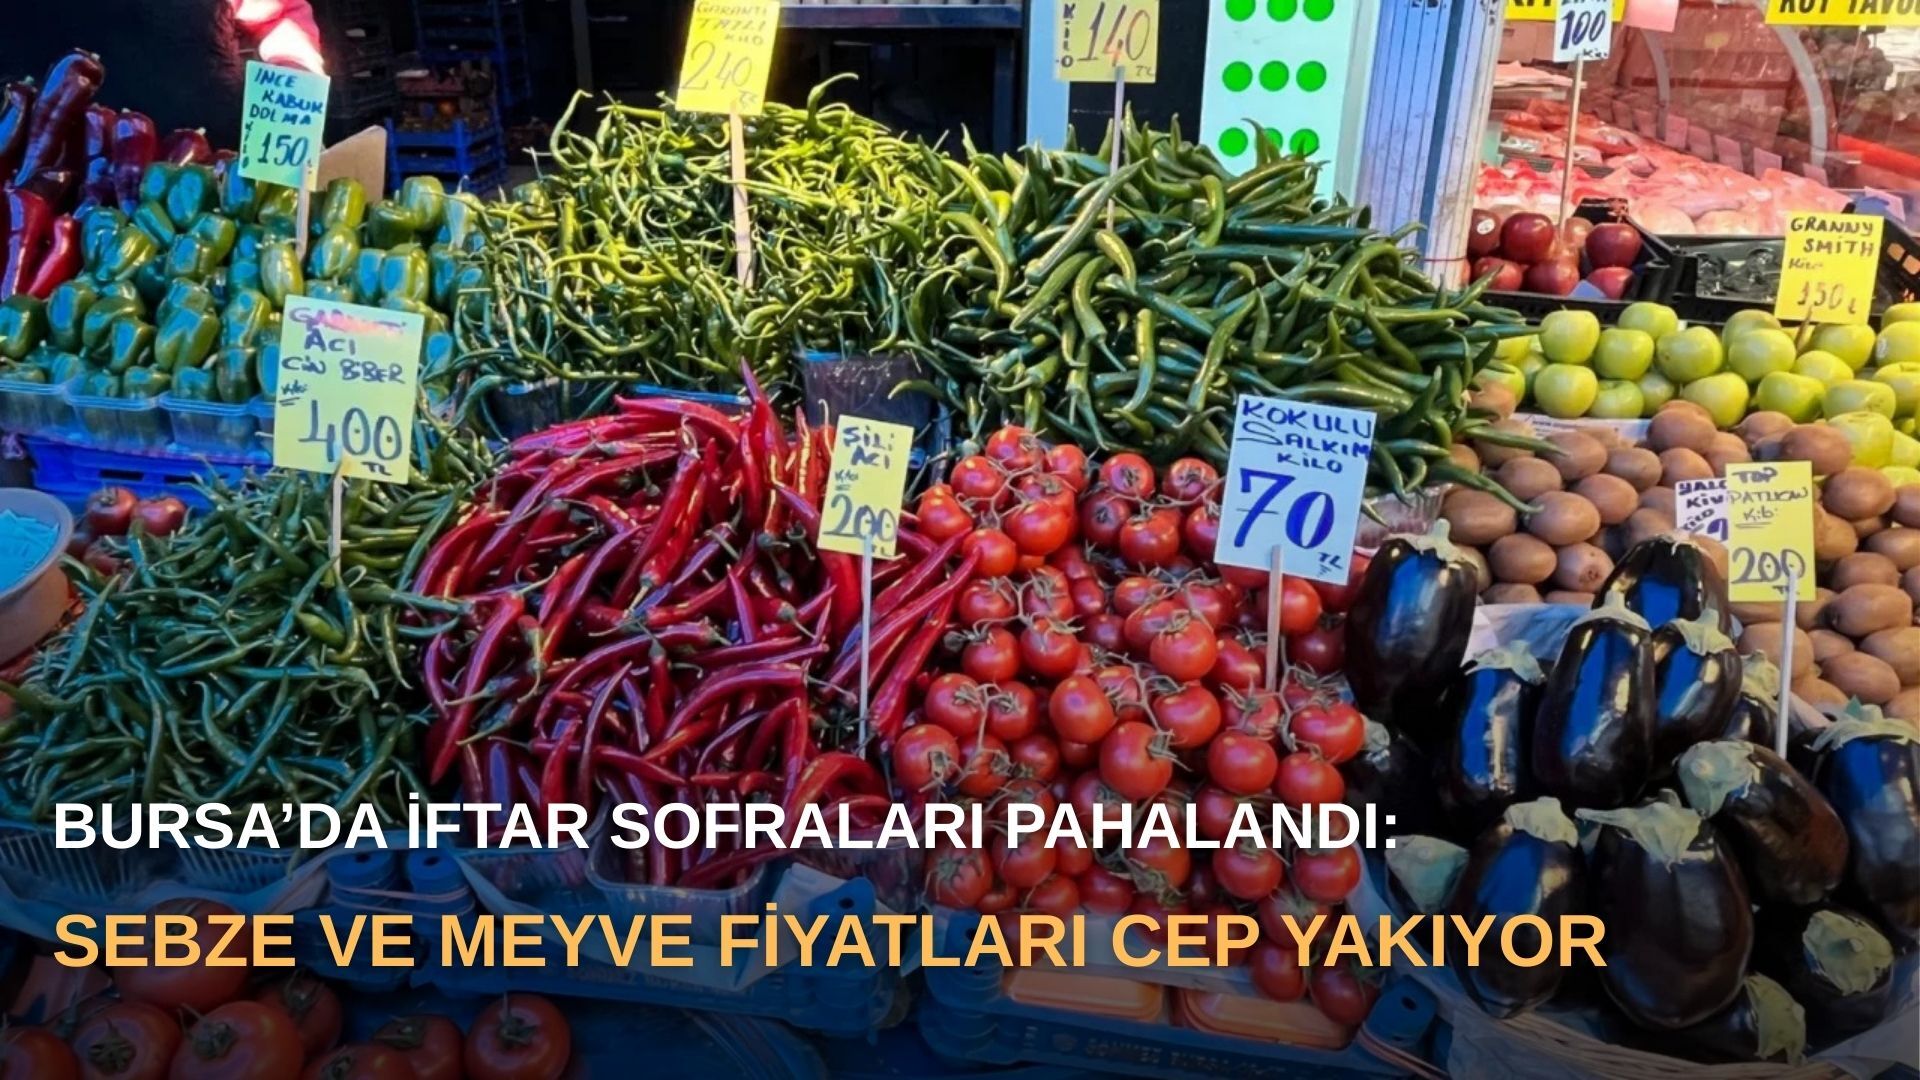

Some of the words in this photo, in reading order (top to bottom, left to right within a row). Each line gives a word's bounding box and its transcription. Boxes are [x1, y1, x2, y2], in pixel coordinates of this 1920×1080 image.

[1077, 1, 1151, 67] 140
[1560, 10, 1606, 50] 100
[681, 40, 752, 89] 240
[257, 132, 309, 166] 150
[1790, 216, 1873, 236] GRANNY
[1797, 281, 1844, 310] 150
[304, 328, 356, 355] ACI
[298, 400, 402, 463] 400
[1242, 399, 1371, 438] KOKULU
[1236, 420, 1372, 459] SALKIM
[822, 493, 896, 541] 200
[1234, 467, 1335, 549] 70
[1318, 551, 1343, 570] TL
[1731, 546, 1805, 584] 200
